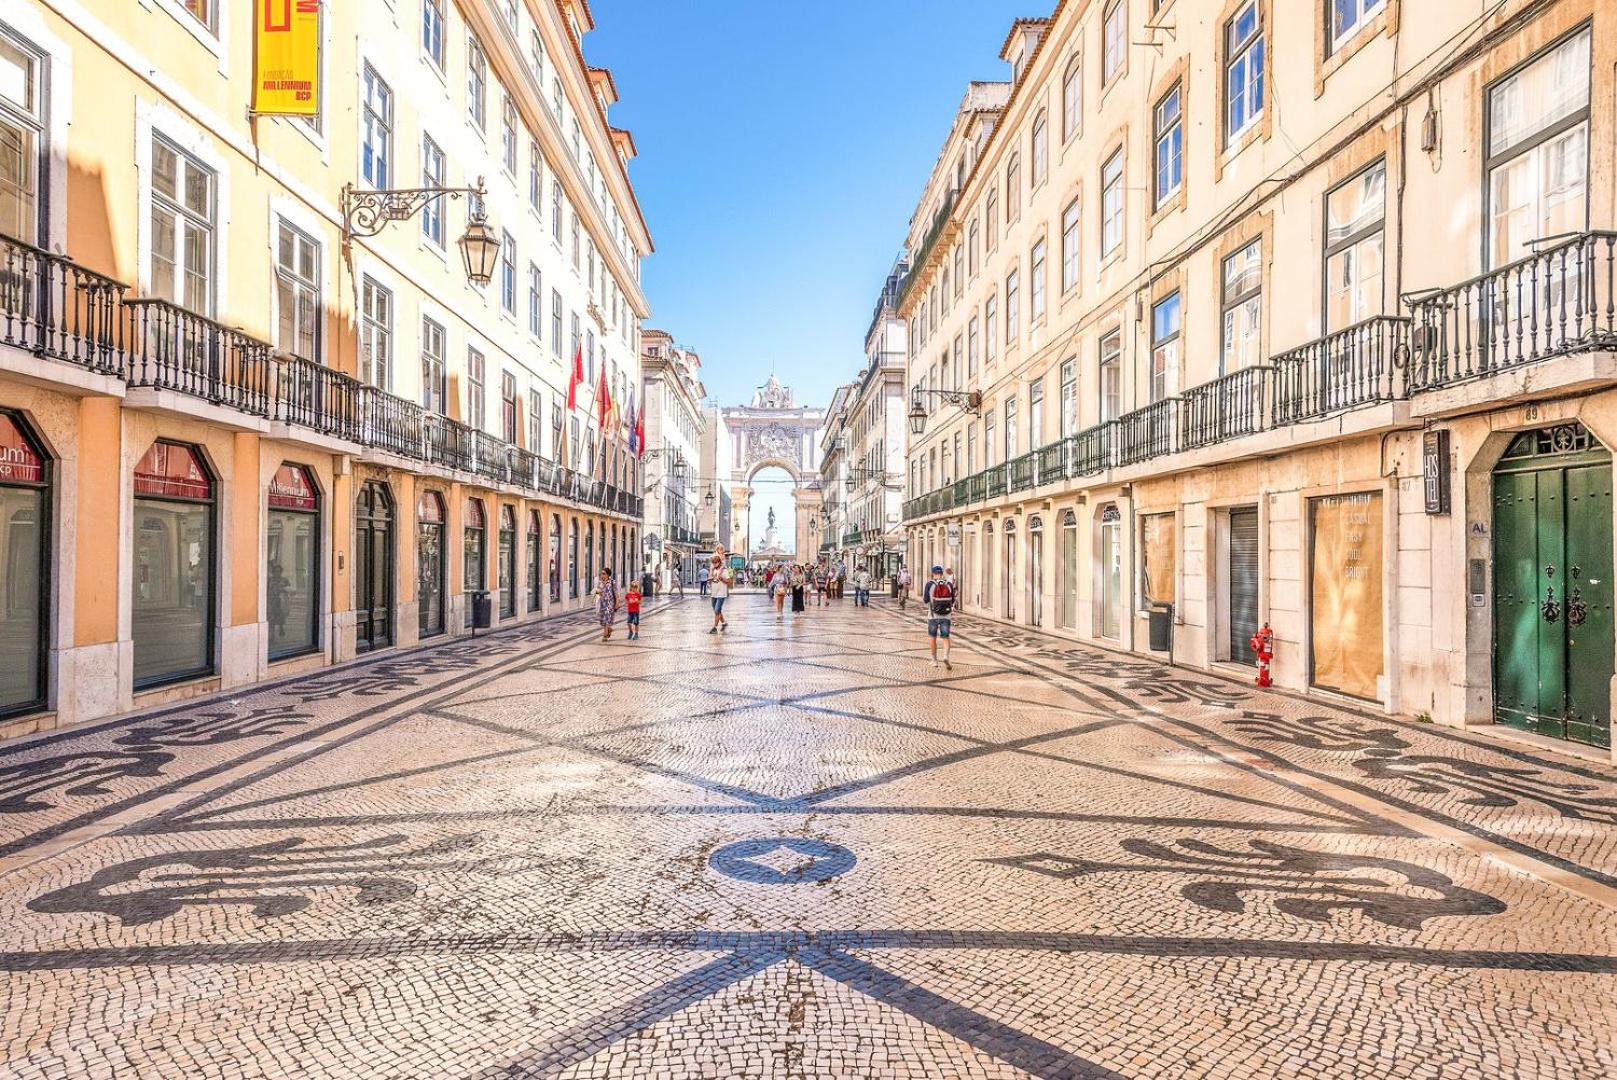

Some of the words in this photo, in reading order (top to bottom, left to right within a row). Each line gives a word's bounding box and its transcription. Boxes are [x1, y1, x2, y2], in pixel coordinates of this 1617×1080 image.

[263, 81, 312, 90] MILLENNIUM
[296, 91, 312, 101] BCP
[1525, 408, 1538, 420] 89
[1473, 523, 1487, 534] AL
